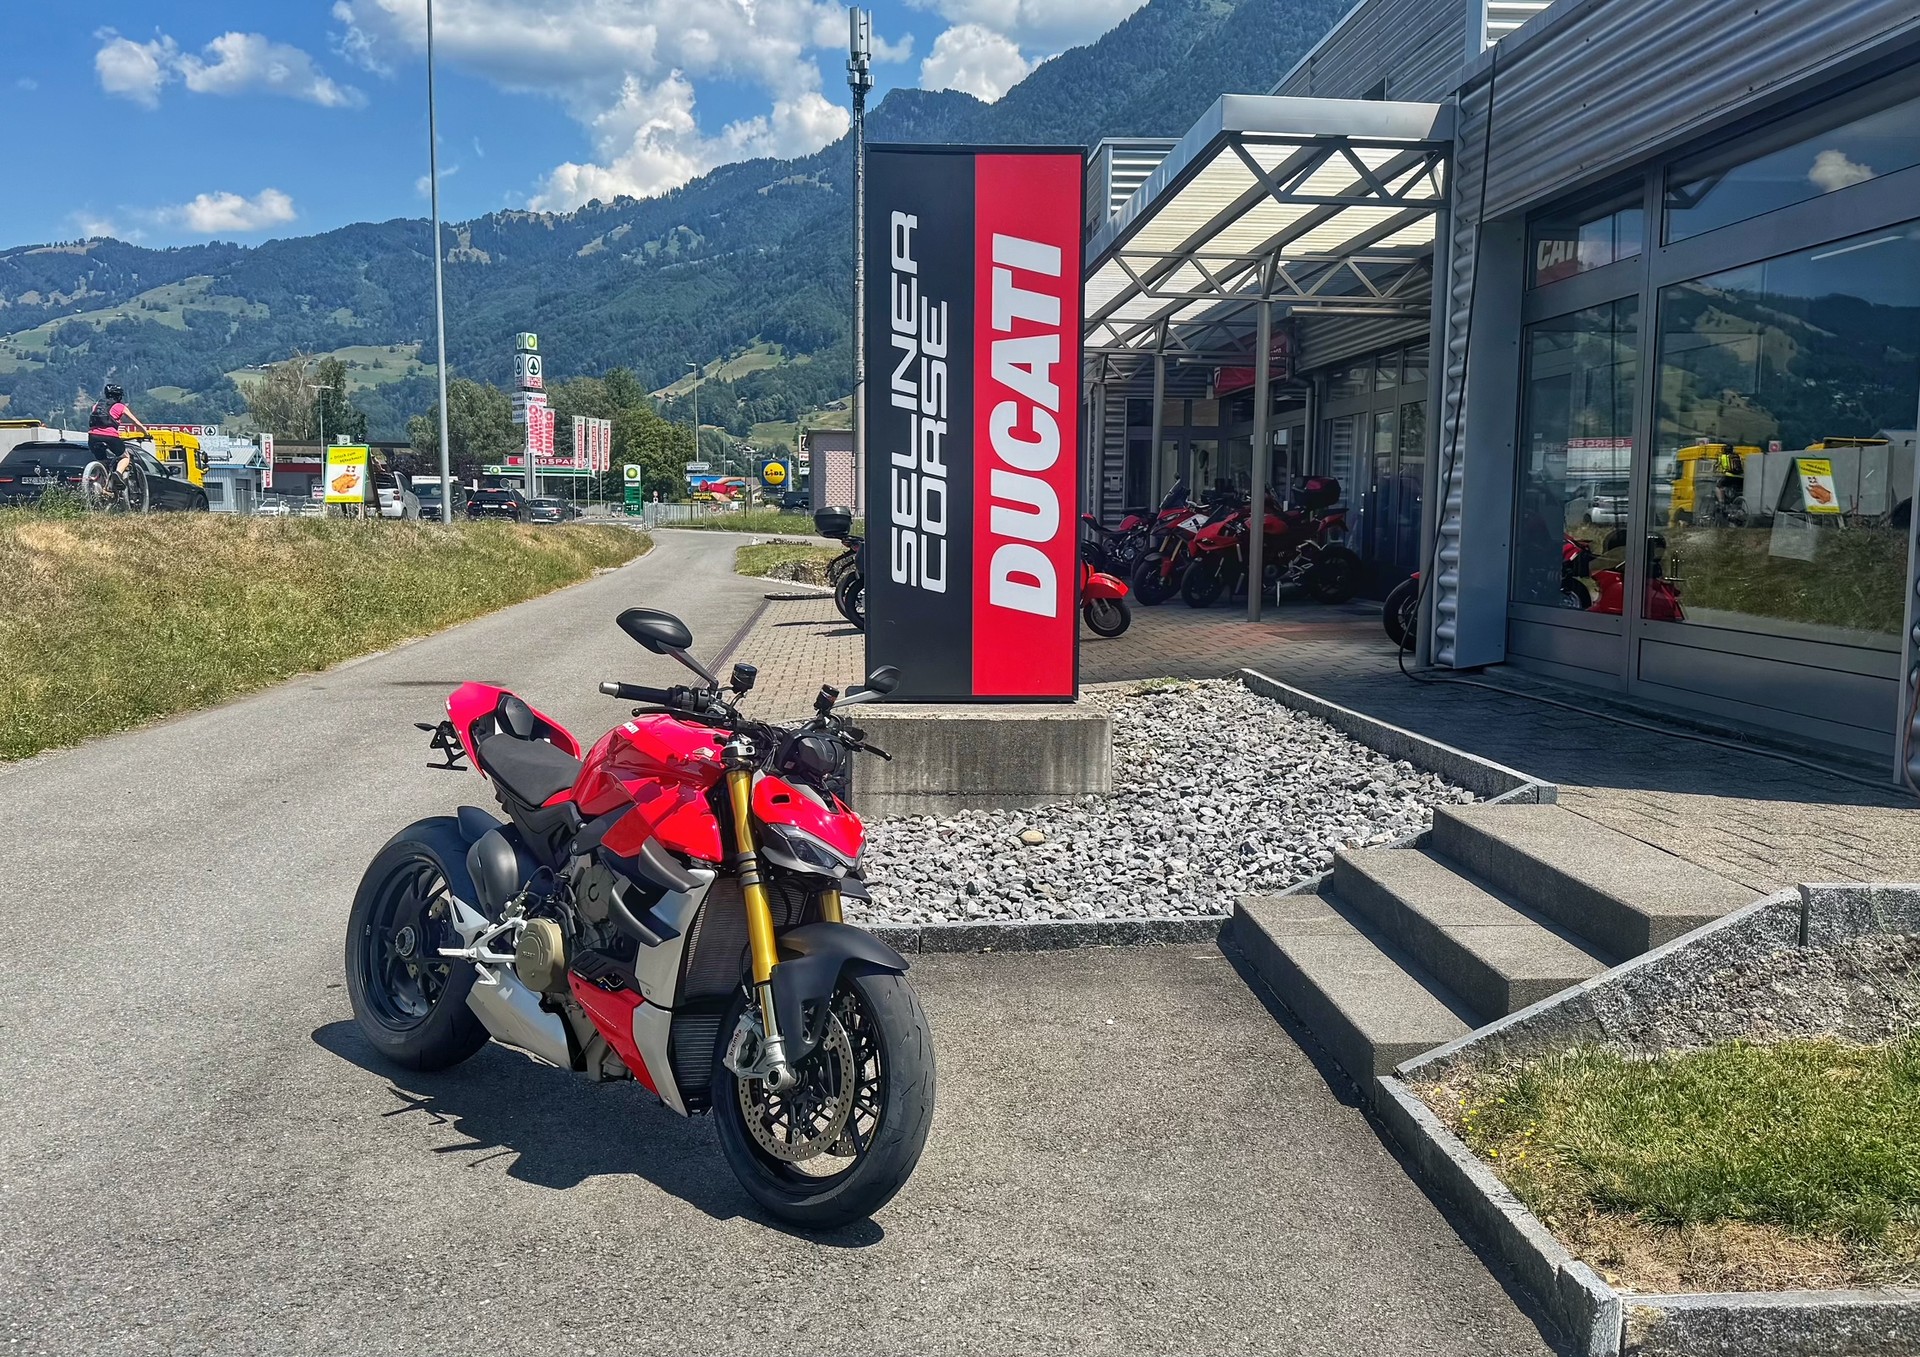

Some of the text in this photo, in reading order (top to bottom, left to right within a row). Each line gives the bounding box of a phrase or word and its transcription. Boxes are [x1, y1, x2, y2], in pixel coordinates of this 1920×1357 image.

[545, 411, 553, 455] JUMBO
[891, 209, 918, 587] SELINER
[920, 295, 948, 594] CORSE
[989, 232, 1061, 618] DUCATI
[728, 1029, 741, 1056] brembo
